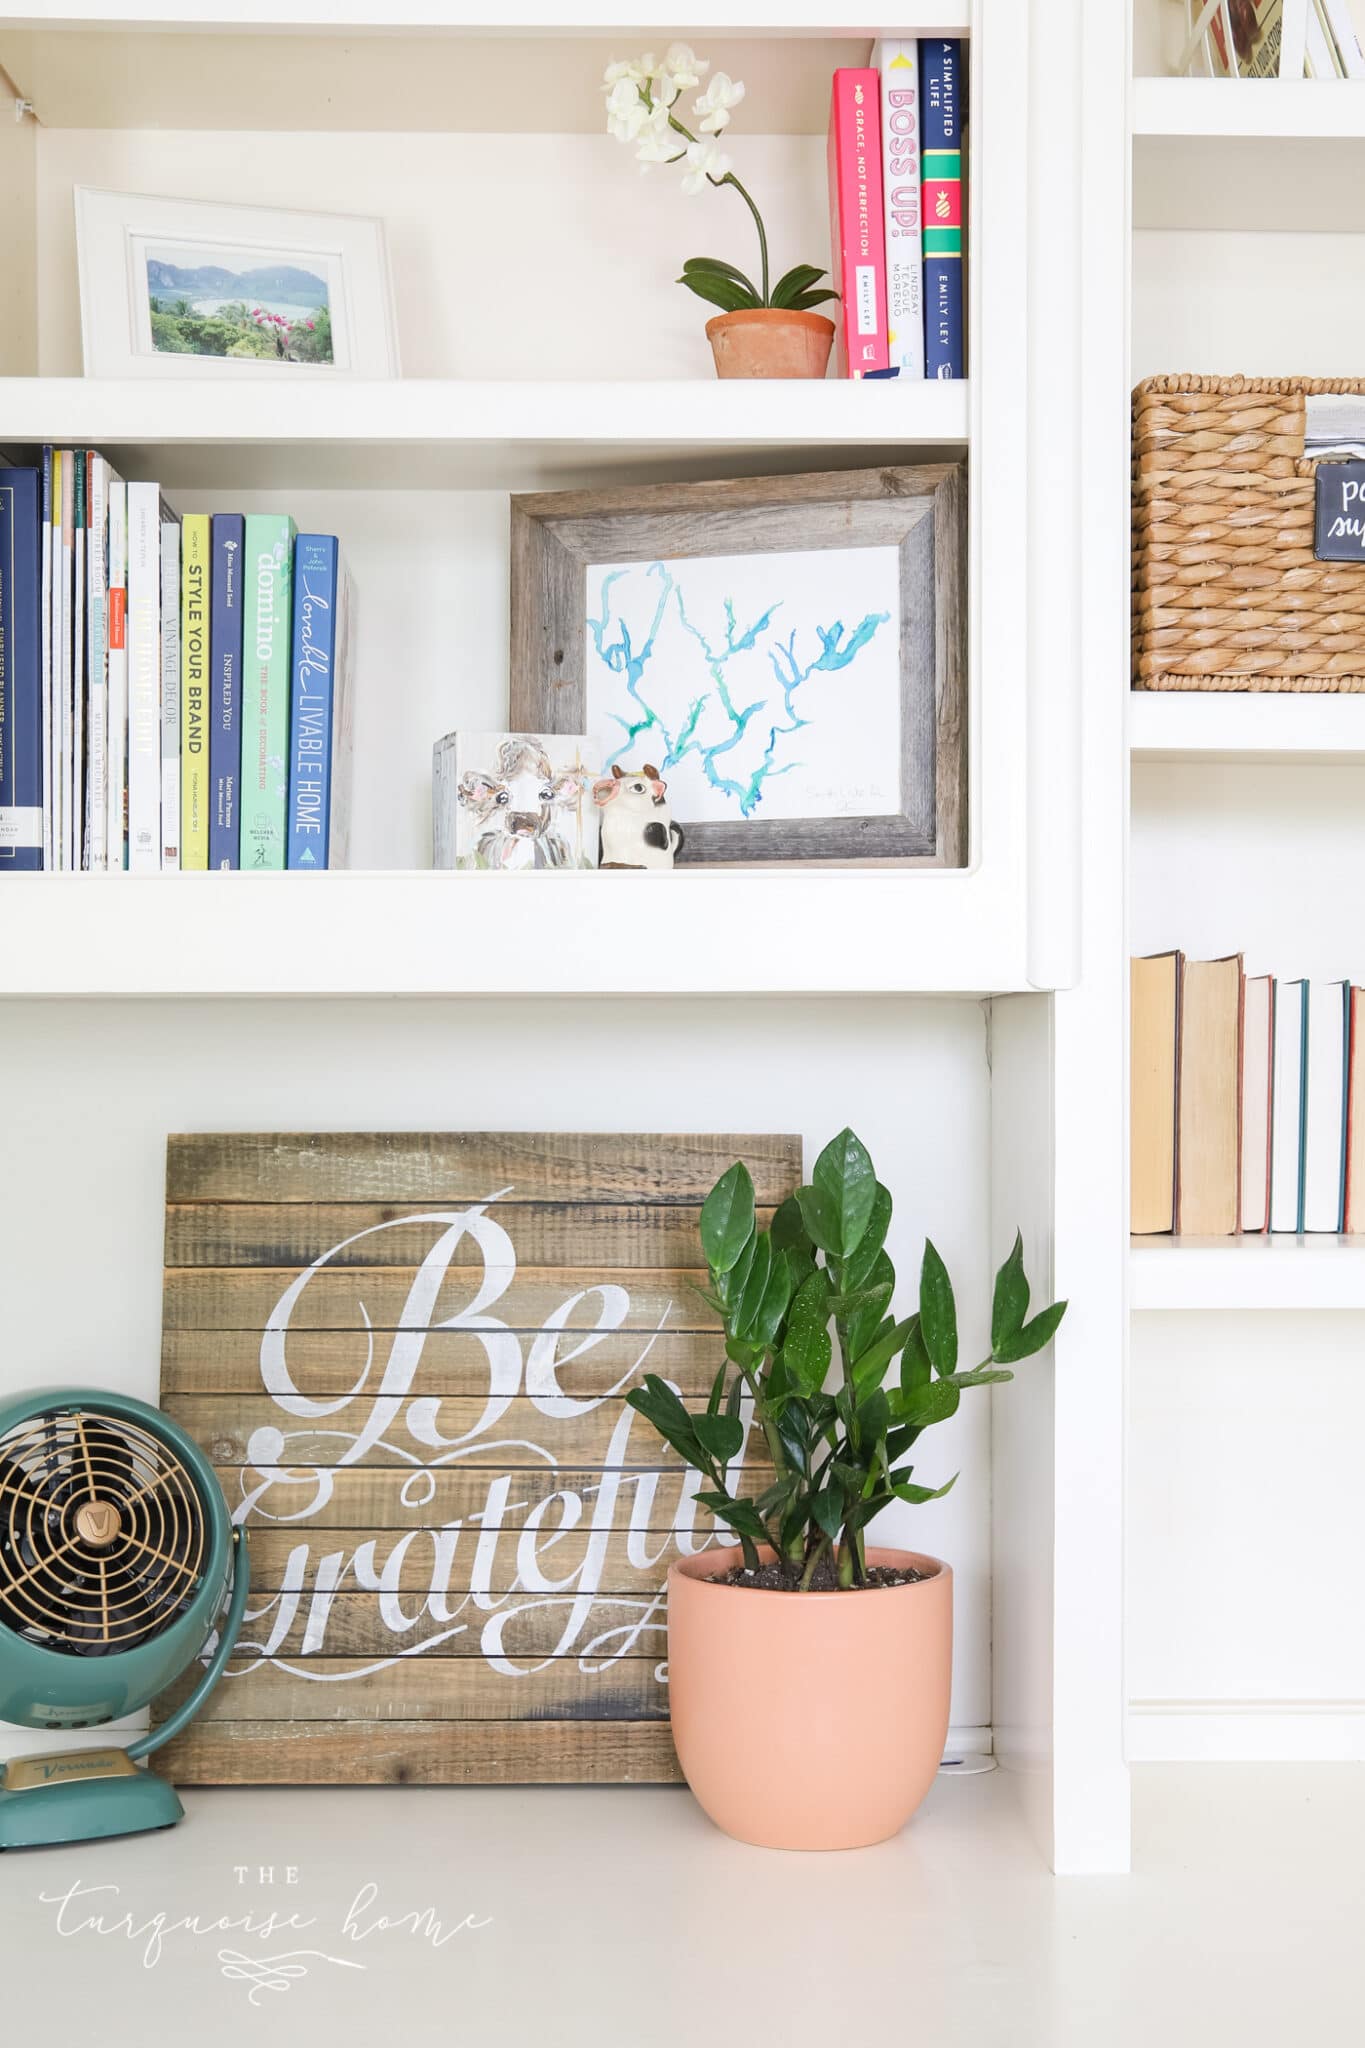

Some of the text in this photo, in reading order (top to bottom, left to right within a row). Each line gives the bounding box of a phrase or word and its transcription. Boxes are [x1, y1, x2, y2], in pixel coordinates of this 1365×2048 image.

[930, 79, 939, 108] LIFE
[943, 43, 953, 137] A SIMPLIFIED
[856, 110, 869, 256] GRACE, NOT PERFECTION
[888, 89, 918, 237] BOSS UP!
[893, 263, 902, 317] MORENO
[902, 266, 911, 314] TEAGUE
[910, 263, 919, 317] LINDSAY
[939, 275, 949, 346] EMILY LEY
[192, 549, 198, 559] TO
[189, 564, 202, 621] STYLE
[256, 553, 281, 661] domino
[164, 617, 177, 674] VINTAGE
[188, 626, 202, 680] YOUR
[259, 664, 269, 686] THE
[188, 686, 202, 754] BRAND
[222, 653, 233, 731] INSPIRED YOU
[260, 689, 269, 715] BOOK
[296, 574, 329, 834] lovable LIVABLE HOME
[258, 728, 269, 790] DECORATING
[257, 1186, 675, 1475] Be
